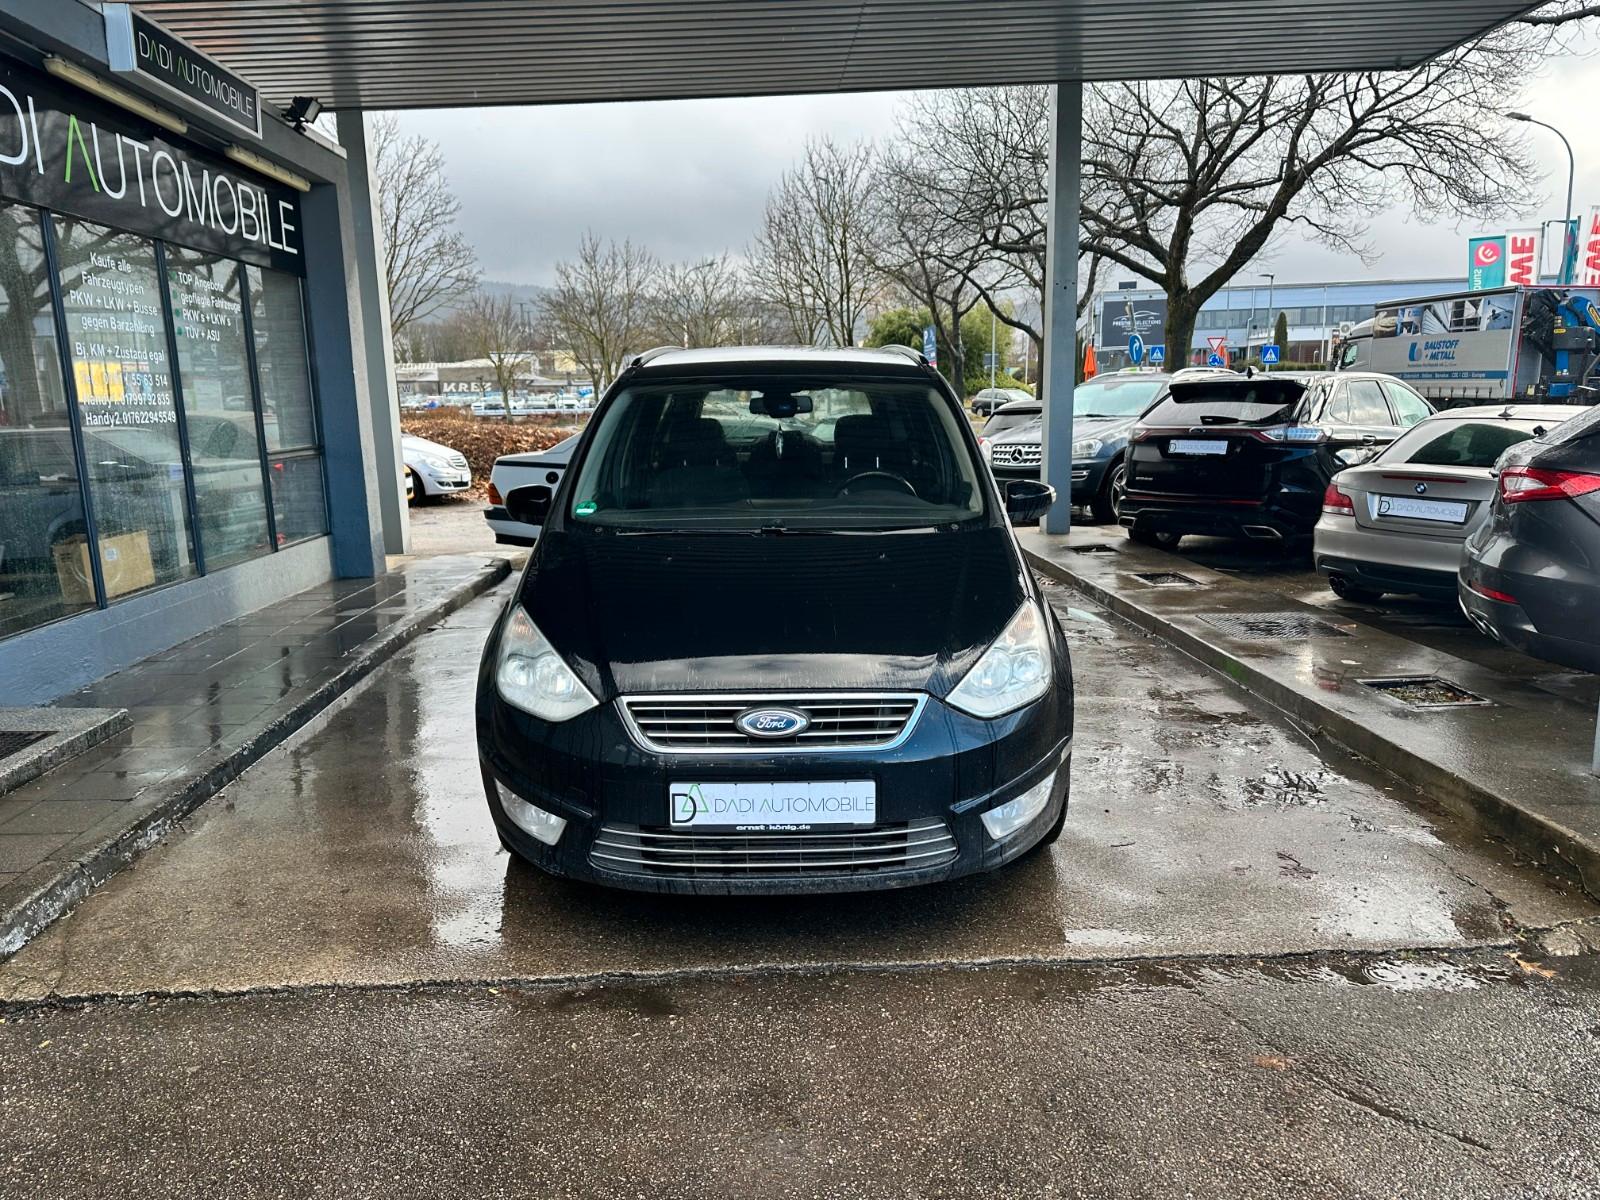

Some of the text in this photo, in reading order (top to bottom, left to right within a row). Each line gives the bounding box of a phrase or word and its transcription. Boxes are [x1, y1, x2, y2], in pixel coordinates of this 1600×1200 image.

[138, 31, 254, 119] DADI AUTOMOBILE
[64, 114, 298, 255] AUTOMOBILE
[89, 252, 132, 273] Kaufe alle
[82, 271, 144, 295] Fahrzeugtypen
[178, 271, 192, 285] TOP
[70, 290, 93, 306] PKW
[103, 296, 124, 311] LKW
[133, 300, 158, 316] Busse
[81, 316, 155, 337] gegen Barzahlung
[185, 325, 199, 339] TÜV
[207, 329, 220, 342] ASU
[1424, 339, 1459, 350] BAUSTOFF
[90, 344, 105, 356] KM
[115, 346, 148, 359] Zustand
[149, 349, 165, 364] egal
[1429, 351, 1455, 360] METALL
[155, 374, 168, 387] 514
[756, 716, 787, 729] Ford
[714, 798, 754, 813] DADI
[759, 796, 874, 813] AUTOMOBILE
